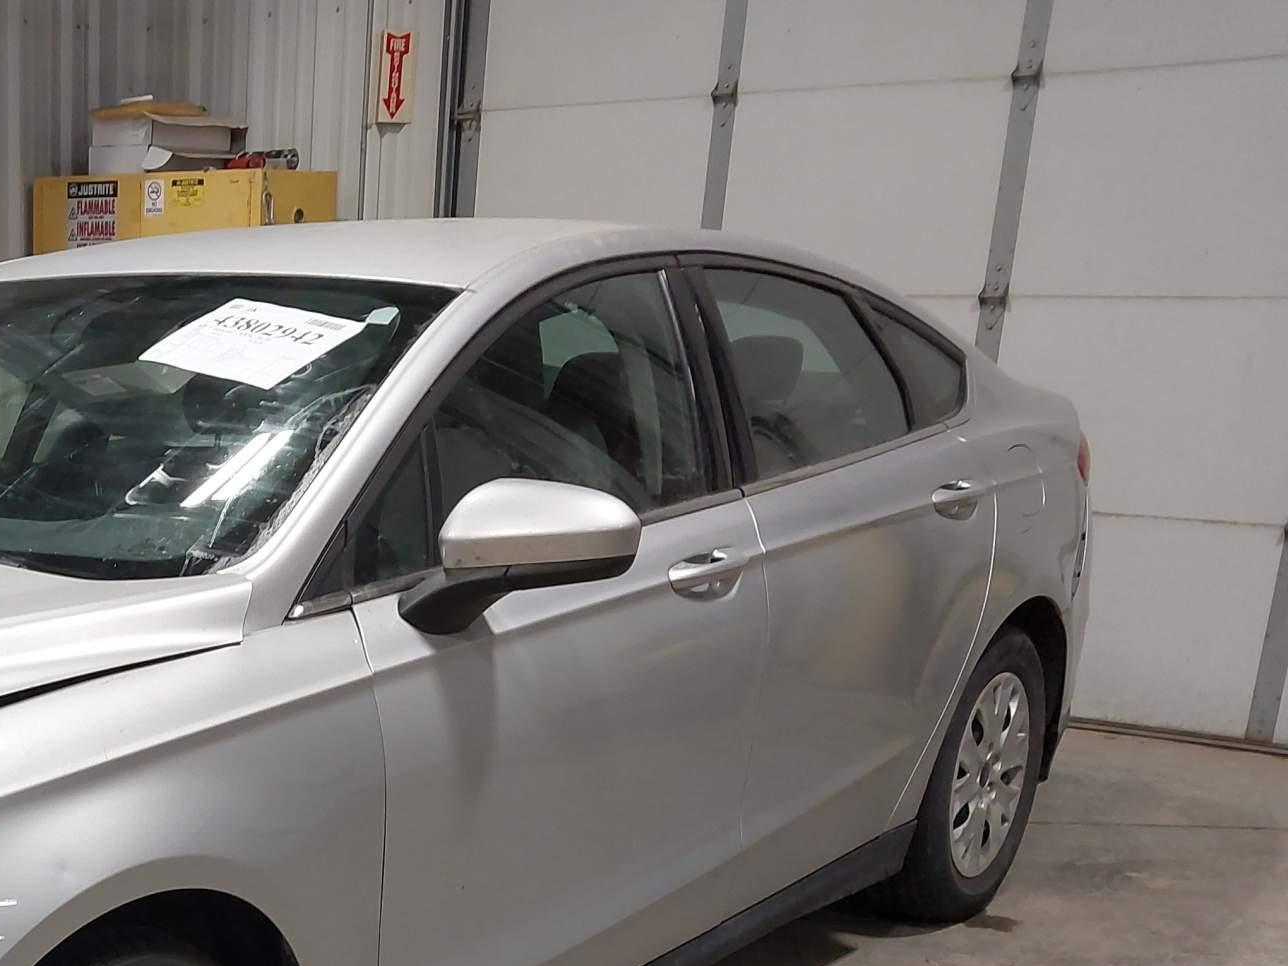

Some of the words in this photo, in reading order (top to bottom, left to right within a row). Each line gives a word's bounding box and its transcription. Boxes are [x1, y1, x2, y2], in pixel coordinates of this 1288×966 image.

[76, 199, 116, 216] FLAMMABLE
[76, 221, 116, 238] INFLAMABLE
[214, 315, 325, 345] 43802942
